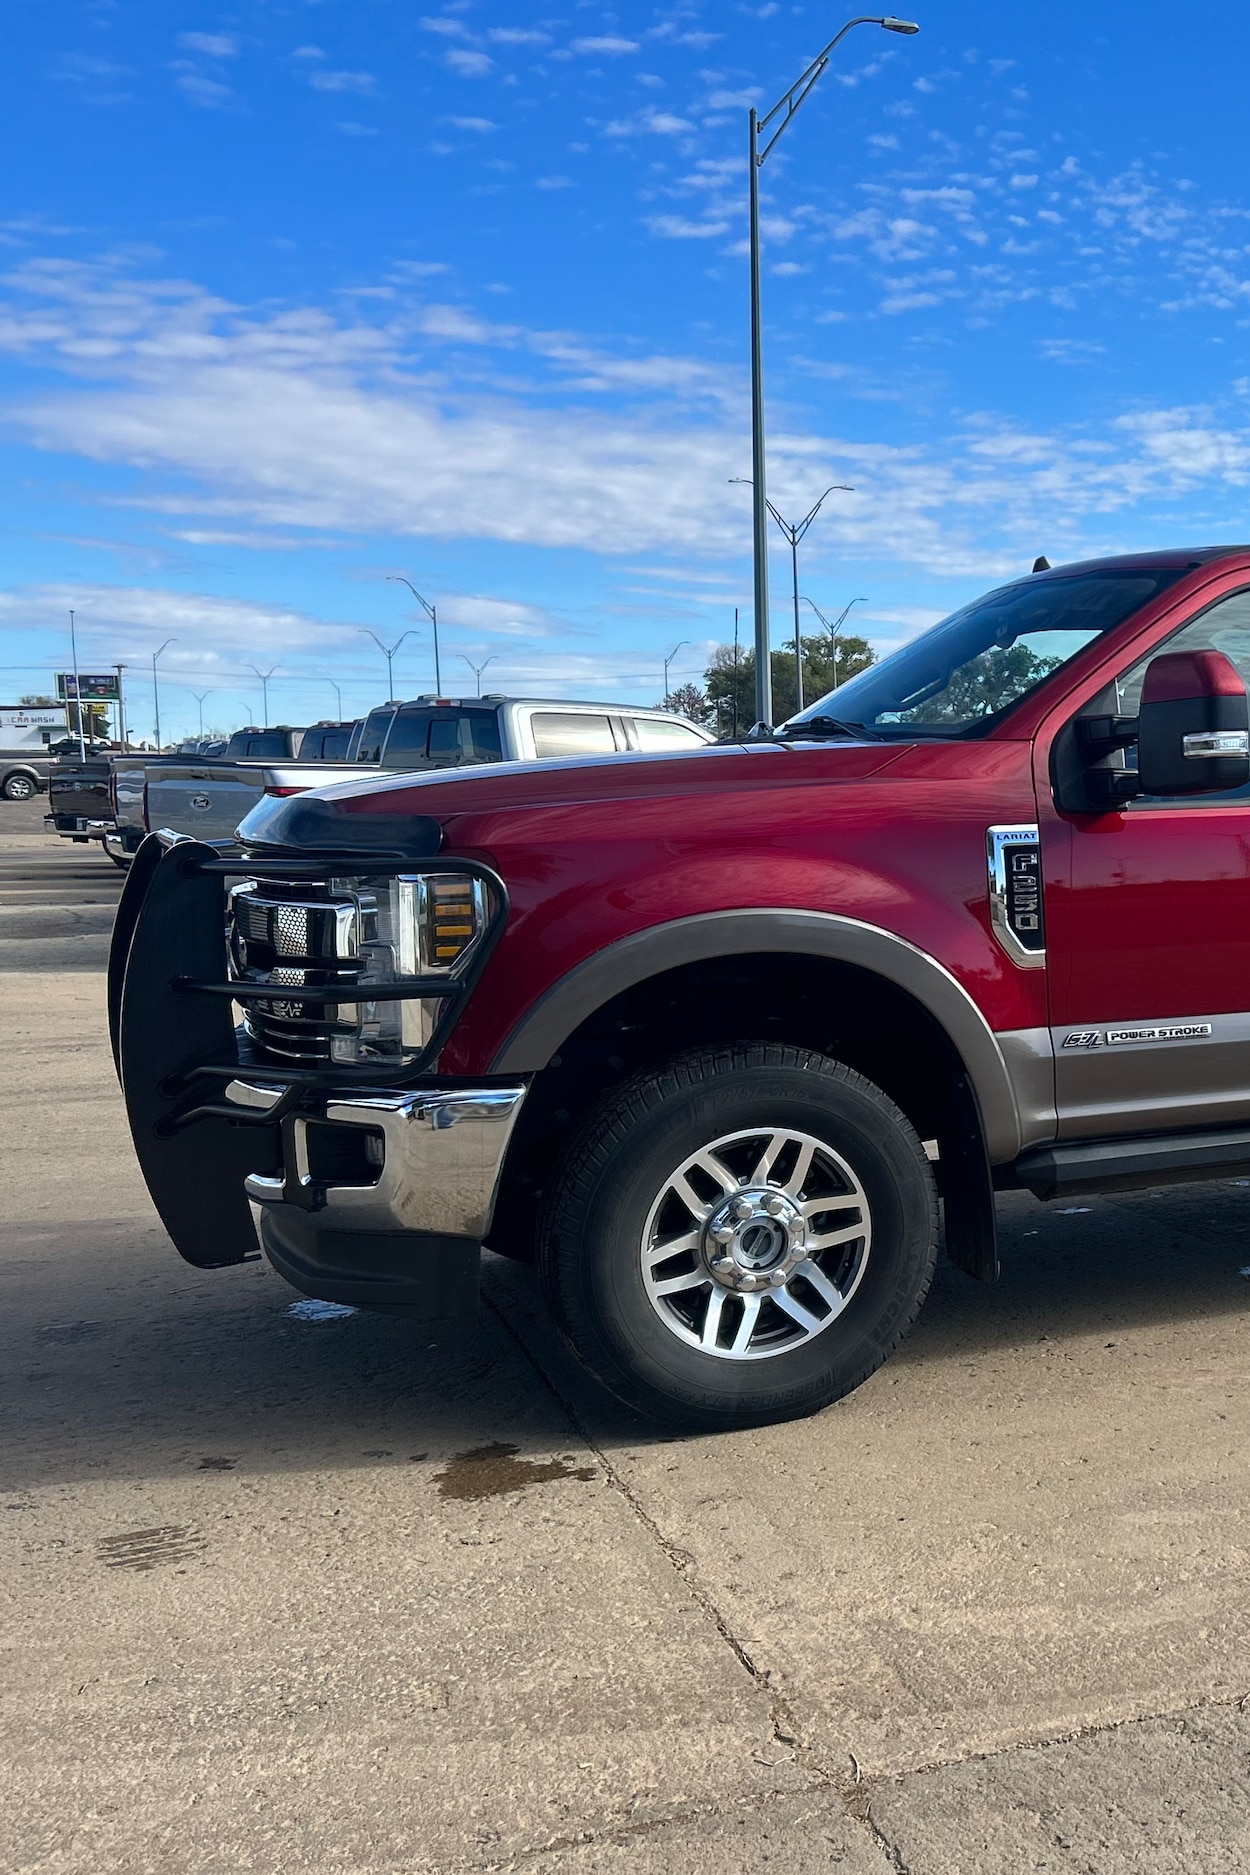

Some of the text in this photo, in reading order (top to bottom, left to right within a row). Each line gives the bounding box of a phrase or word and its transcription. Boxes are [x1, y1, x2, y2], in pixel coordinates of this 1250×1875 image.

[996, 832, 1037, 841] LARIAT
[1110, 1030, 1156, 1042] POWER
[1158, 1025, 1210, 1037] STROKE
